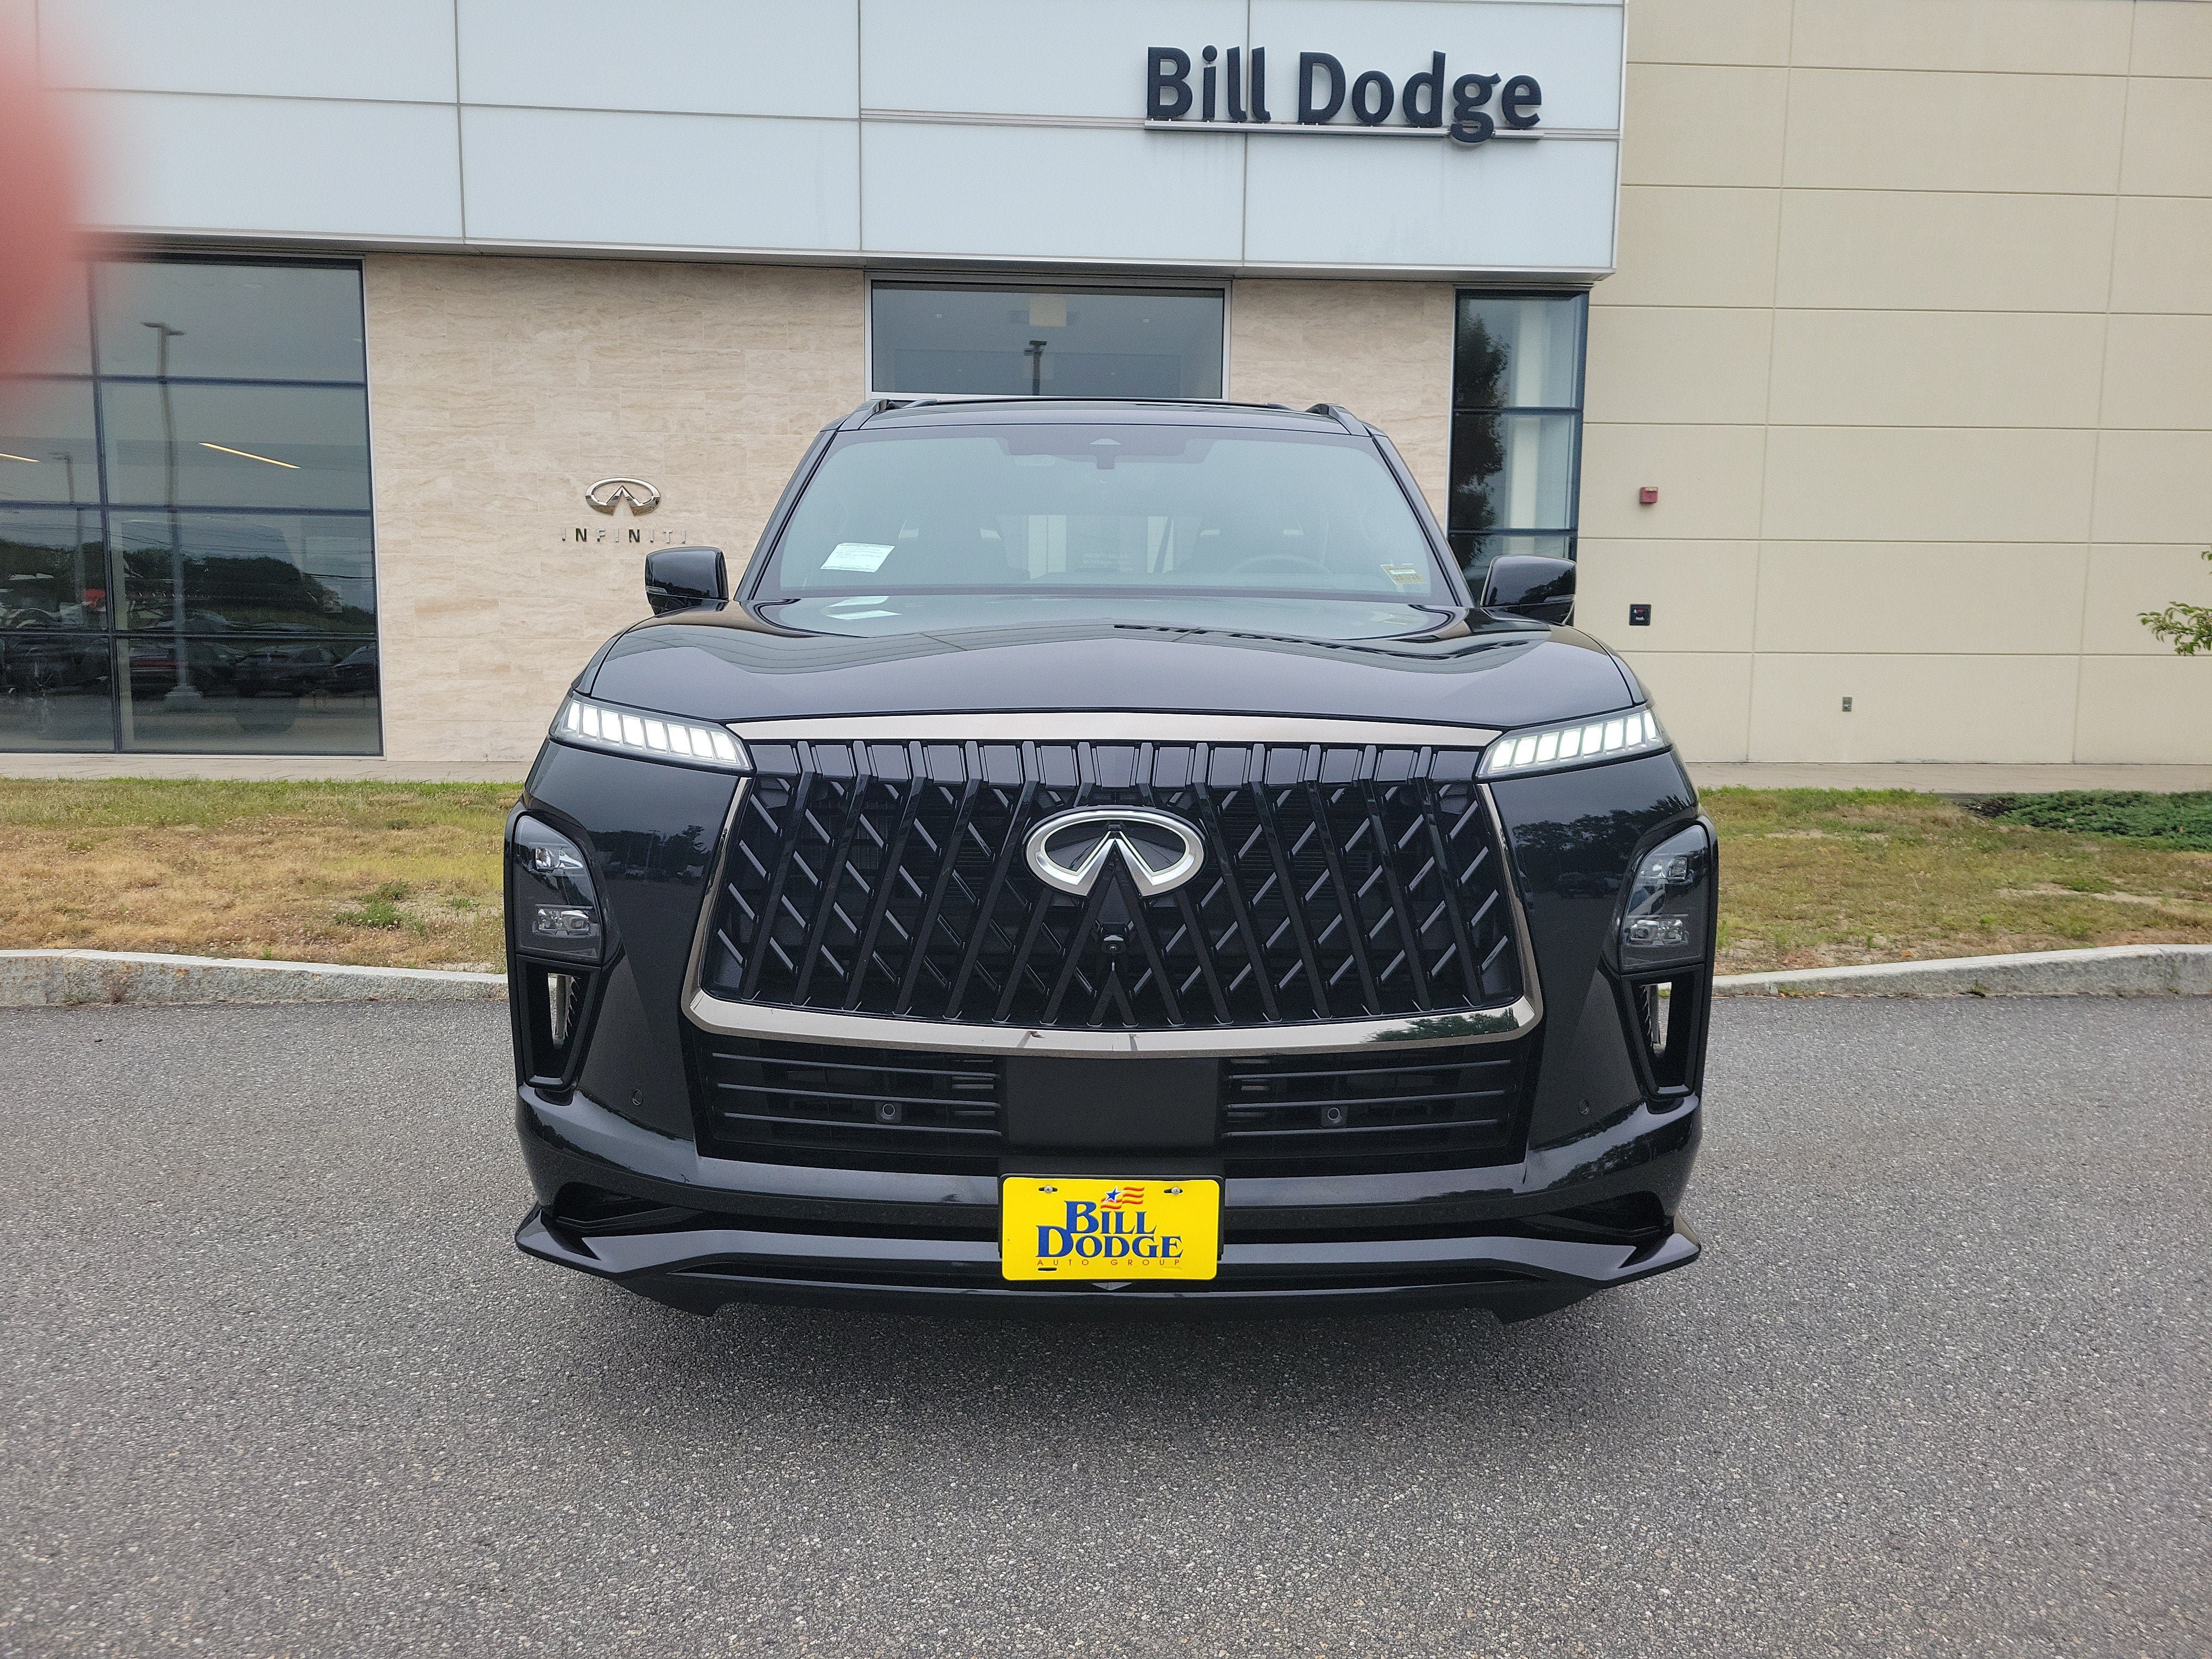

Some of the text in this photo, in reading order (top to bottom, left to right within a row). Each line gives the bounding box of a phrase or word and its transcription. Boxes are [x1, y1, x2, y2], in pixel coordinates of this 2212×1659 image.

[1146, 44, 1542, 143] Bill Dodge
[561, 527, 686, 544] INFINITI
[1064, 1200, 1157, 1234] BILL
[1035, 1224, 1184, 1259] DODGE
